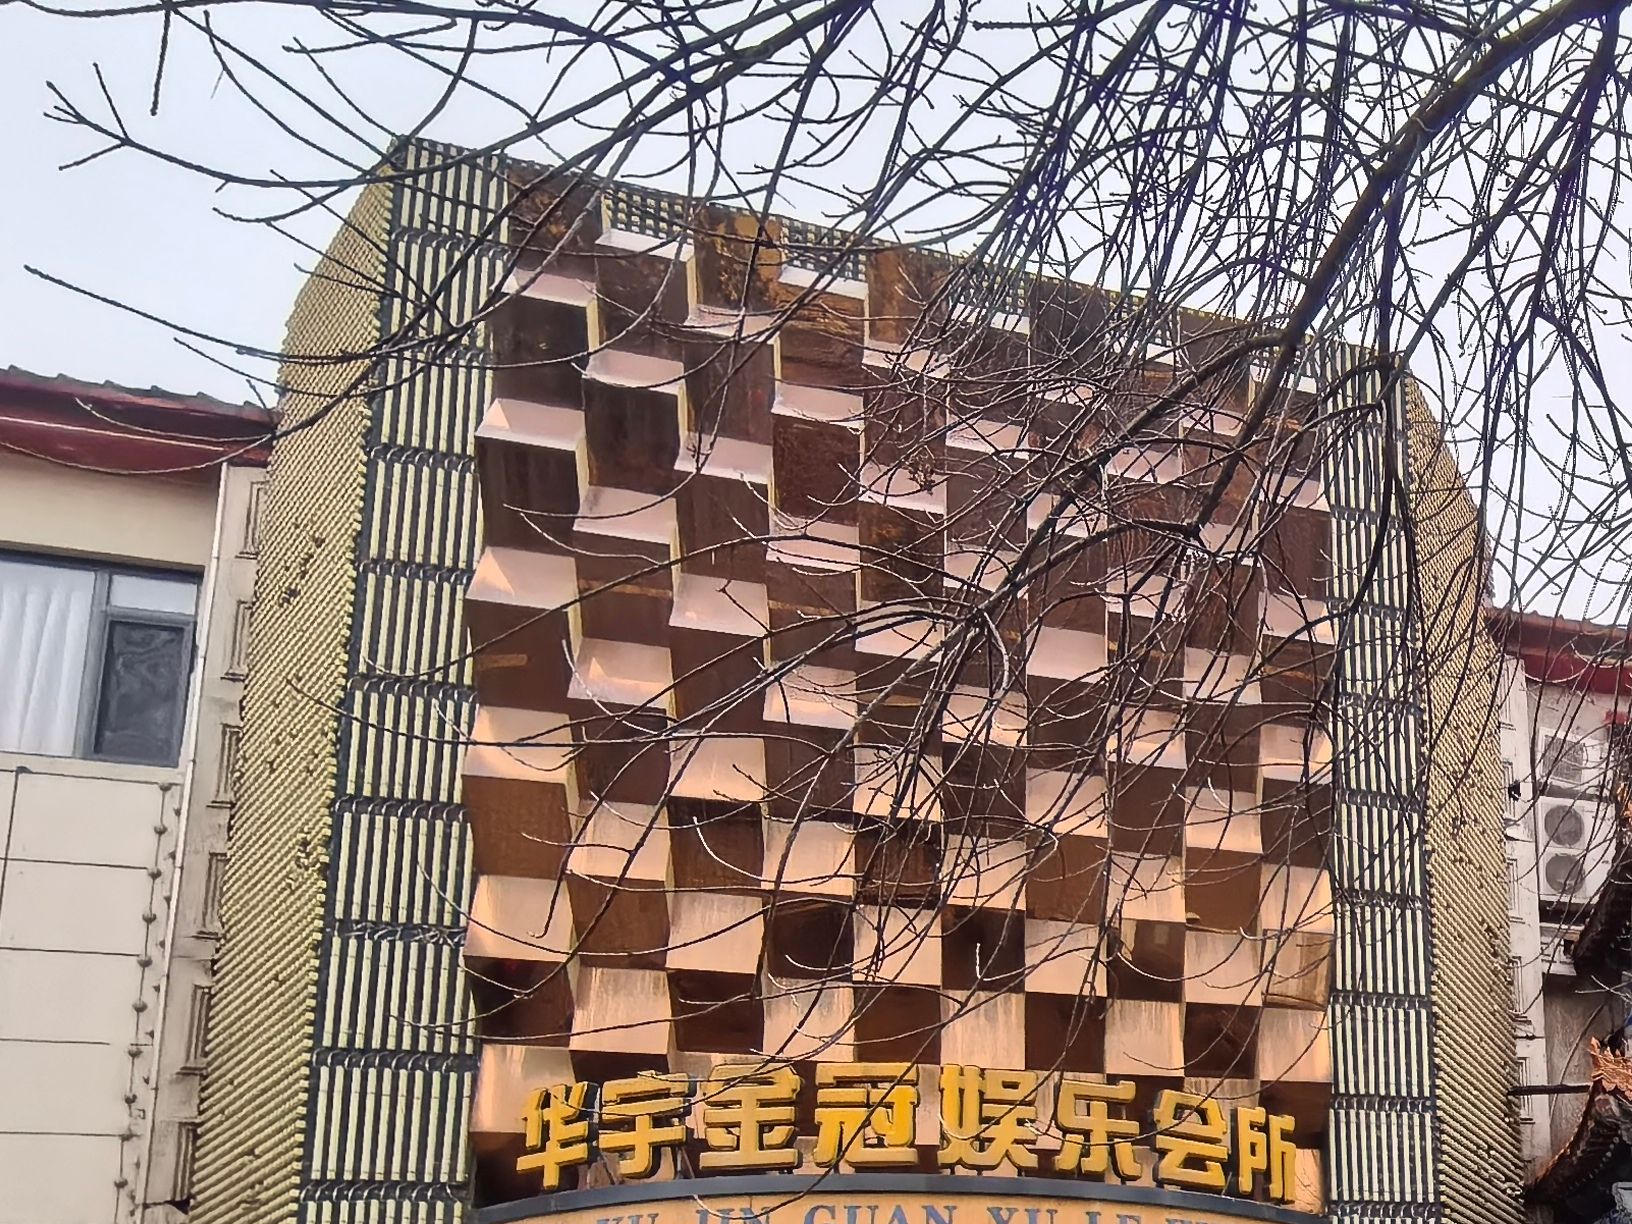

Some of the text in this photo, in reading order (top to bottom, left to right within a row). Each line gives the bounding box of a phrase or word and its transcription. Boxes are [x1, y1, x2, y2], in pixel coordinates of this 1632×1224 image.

[515, 1062, 1297, 1202] 华宇金冠娱乐会所
